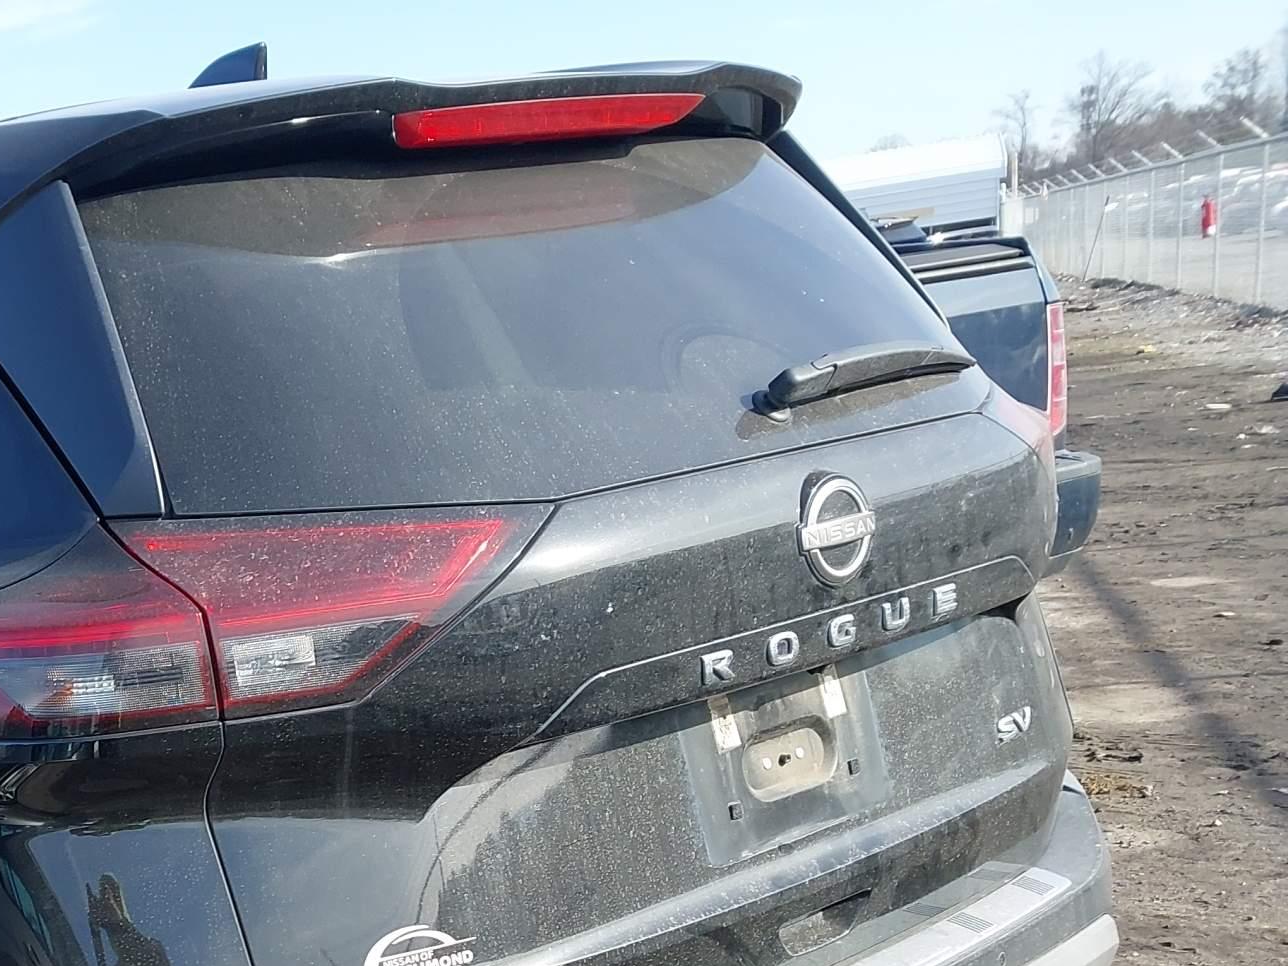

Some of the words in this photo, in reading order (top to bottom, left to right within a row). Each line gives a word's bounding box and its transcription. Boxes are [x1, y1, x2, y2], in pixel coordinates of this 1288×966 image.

[806, 513, 875, 547] NISSAN
[700, 582, 959, 686] ROGUE
[997, 705, 1032, 740] SV
[420, 950, 434, 962] OF
